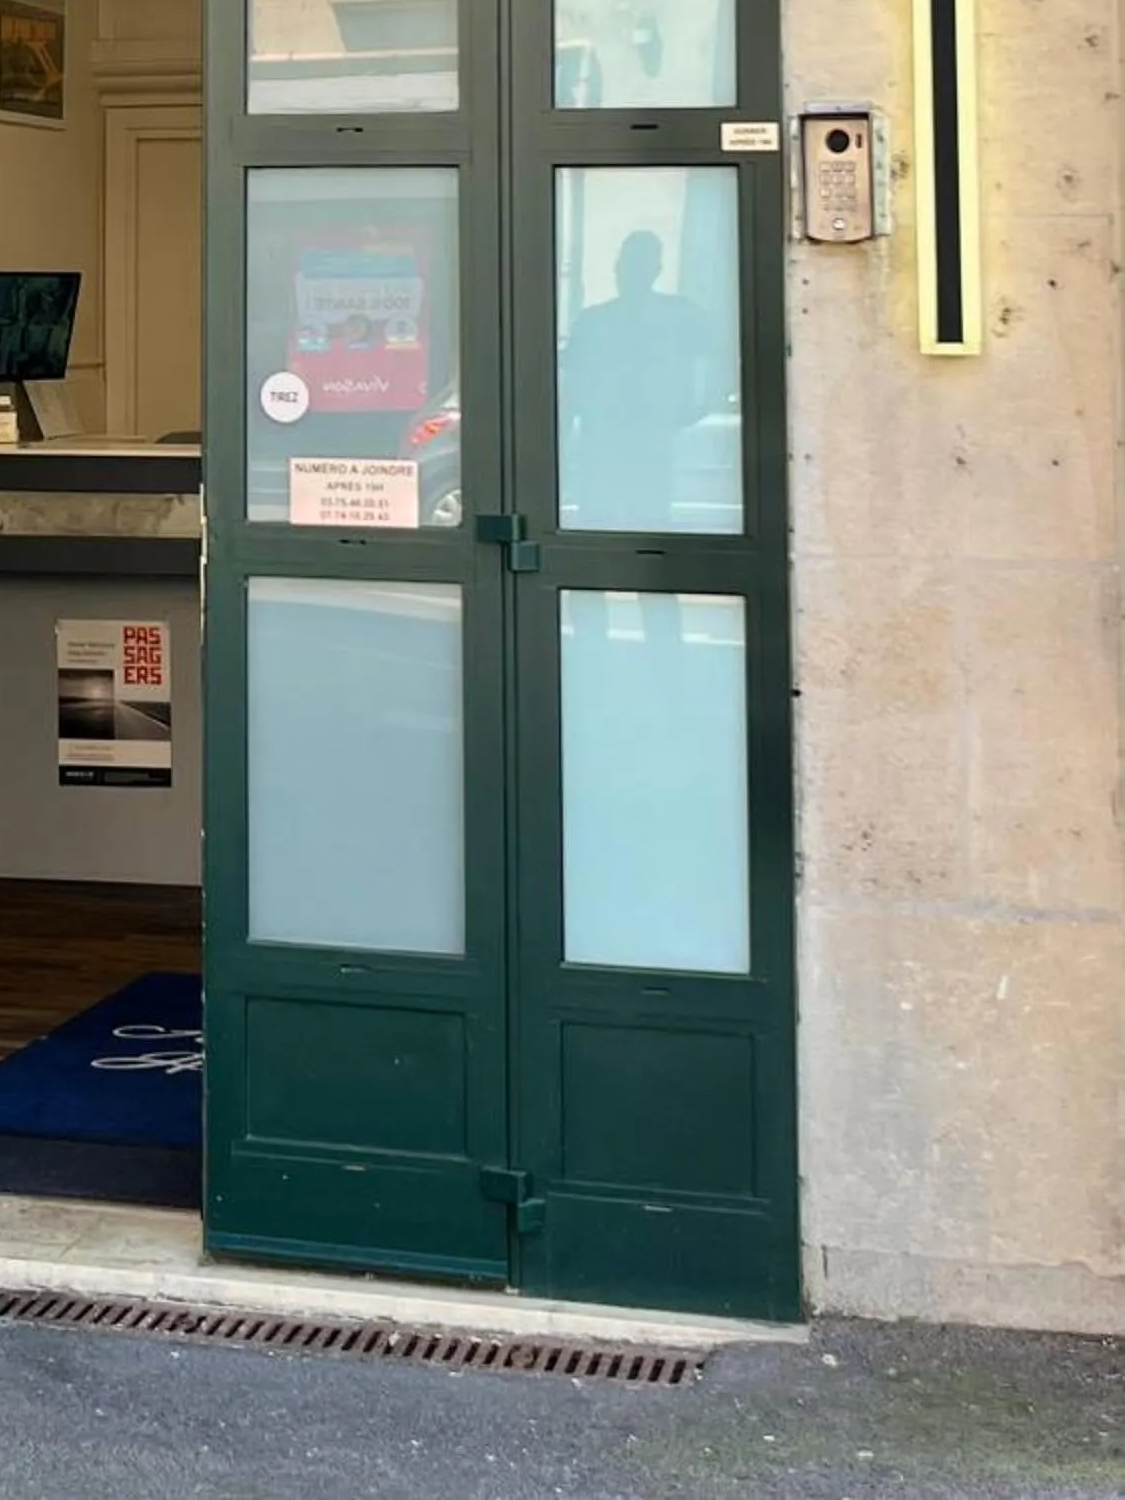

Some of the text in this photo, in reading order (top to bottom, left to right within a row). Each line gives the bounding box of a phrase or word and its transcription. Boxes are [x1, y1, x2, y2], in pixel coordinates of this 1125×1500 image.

[270, 391, 299, 403] TIREZ
[362, 464, 414, 477] JOINDRE
[123, 626, 161, 645] PAS
[123, 646, 162, 665] SAG
[123, 666, 162, 685] ERS
